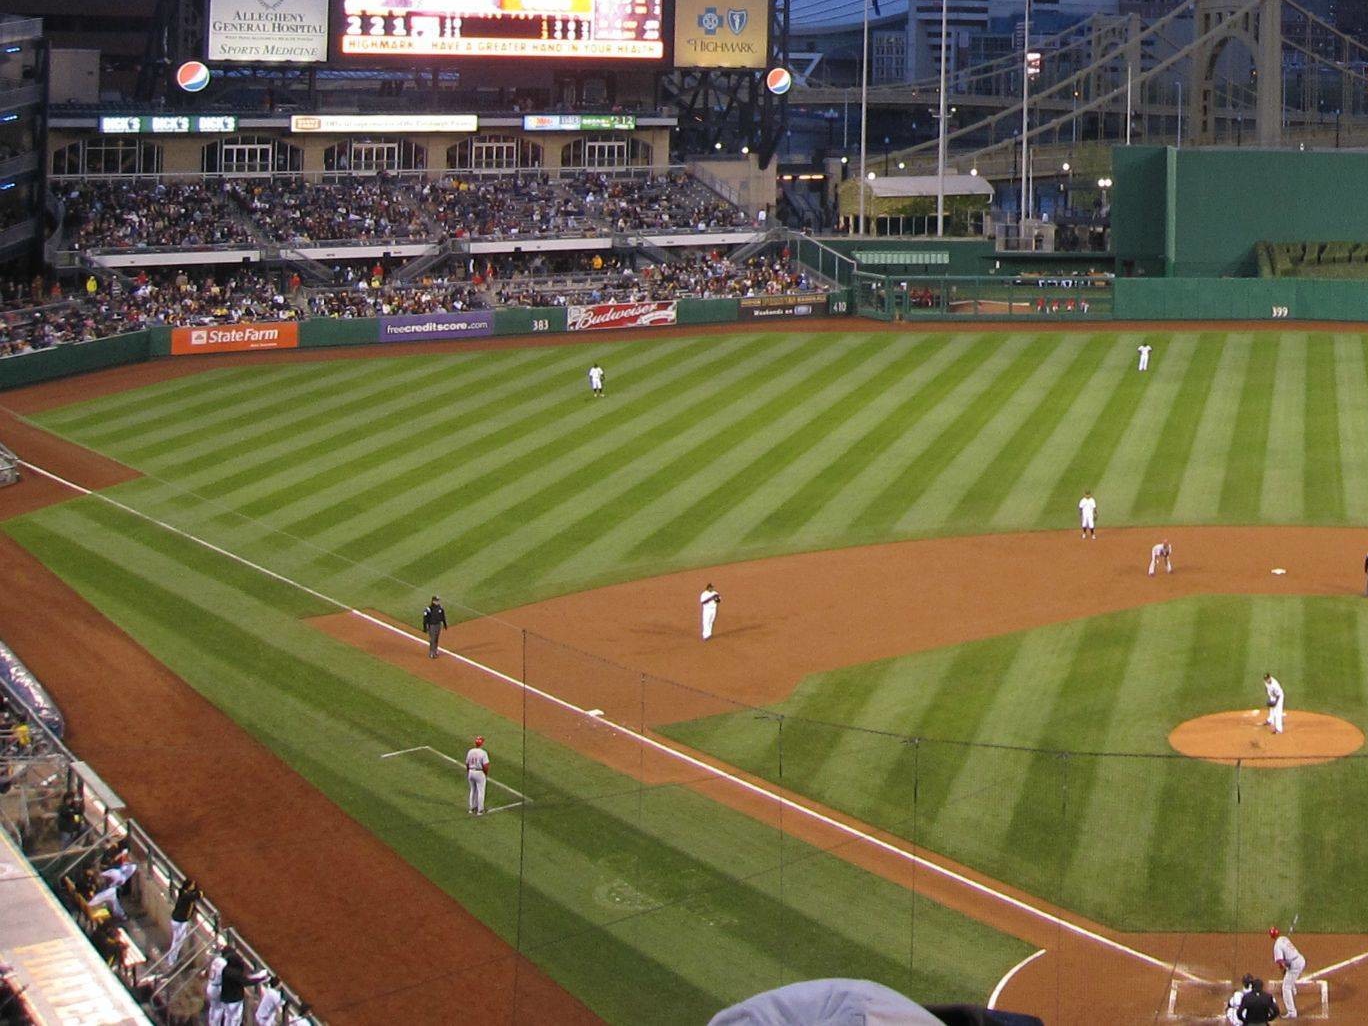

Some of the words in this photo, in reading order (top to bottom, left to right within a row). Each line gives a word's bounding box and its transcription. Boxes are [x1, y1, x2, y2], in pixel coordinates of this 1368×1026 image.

[233, 11, 306, 22] ALLEGHENY
[213, 21, 269, 32] GENERAL
[271, 22, 326, 34] HOSPITAL
[346, 16, 362, 35] 2
[370, 16, 385, 35] 2
[393, 17, 407, 36] 1
[219, 44, 260, 55] SPORTS
[262, 45, 319, 56] MEDICINE
[349, 40, 414, 49] HIGHMARK
[431, 41, 459, 50] HAVE
[584, 45, 611, 53] YOUR
[687, 38, 754, 53] HIGHMARK
[833, 302, 846, 312] 410
[579, 303, 658, 329] Budweiser
[387, 320, 488, 334] freecreditscore.com
[533, 320, 548, 331] 383
